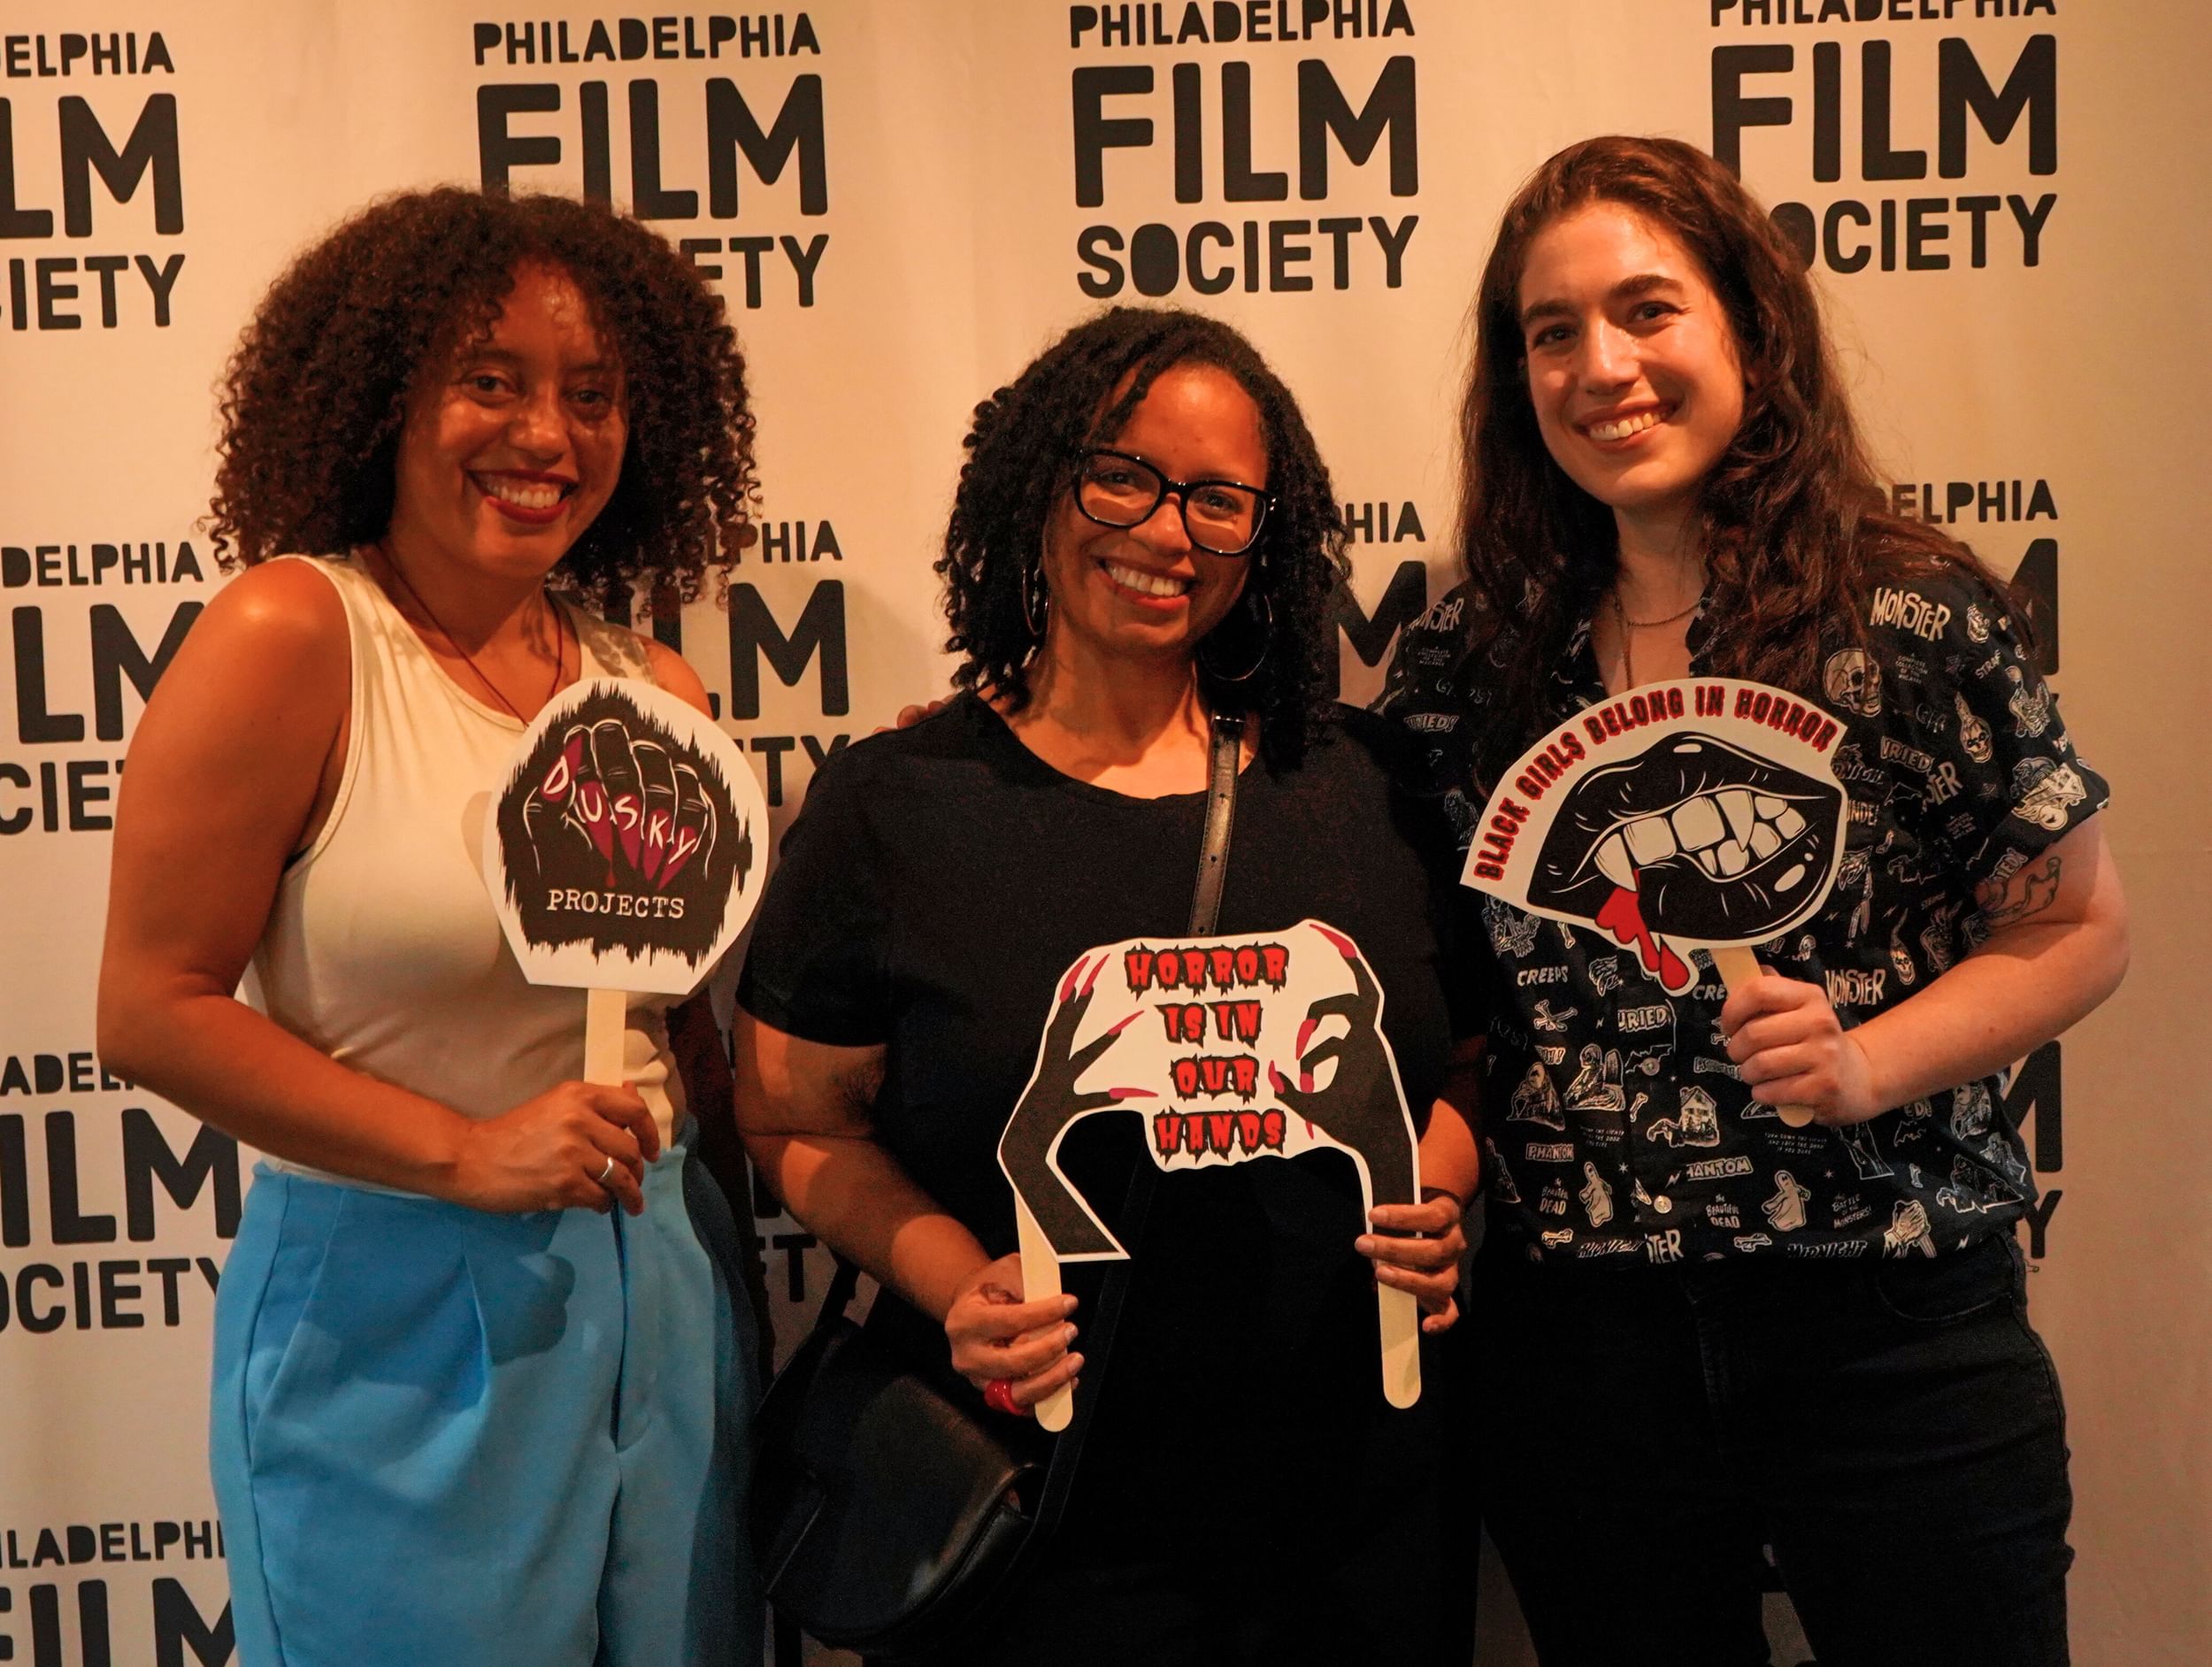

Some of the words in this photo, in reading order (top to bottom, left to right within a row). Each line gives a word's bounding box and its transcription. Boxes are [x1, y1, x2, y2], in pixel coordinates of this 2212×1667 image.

[473, 12, 821, 65] PHILADELPHIA
[1071, 0, 1416, 48] PHILADELPHIA
[0, 32, 175, 77] ELPHIA
[1072, 55, 1419, 208] FILM
[1712, 34, 2057, 182] FILM
[0, 93, 184, 239] LM
[477, 73, 828, 221] FILM
[1077, 215, 1419, 298] SOCIETY
[0, 254, 186, 331] IETY
[1337, 501, 1426, 543] HIA
[0, 542, 204, 588] DELPHIA
[1870, 588, 1952, 641] MONSTER
[0, 759, 125, 835] CIE
[737, 734, 850, 807] TY
[1473, 797, 1531, 881] BLACK
[1515, 731, 1586, 800] GIRLS
[1583, 688, 1685, 745] BELONG
[1695, 686, 1725, 717] IN
[1734, 688, 1839, 752] HORROR
[546, 888, 685, 919] PROJECTS
[1124, 941, 1289, 1001] HORROR
[1517, 965, 1569, 987] CREEPS
[1154, 1003, 1206, 1048] IS
[1206, 1000, 1263, 1050] IN
[0, 1051, 134, 1096] ADEL
[1169, 1054, 1259, 1105] OUR
[1154, 1106, 1286, 1164] HANDS
[1709, 1215, 1741, 1229] DEAD
[0, 1257, 220, 1333] CIET
[0, 1520, 227, 1569] LADELPHI
